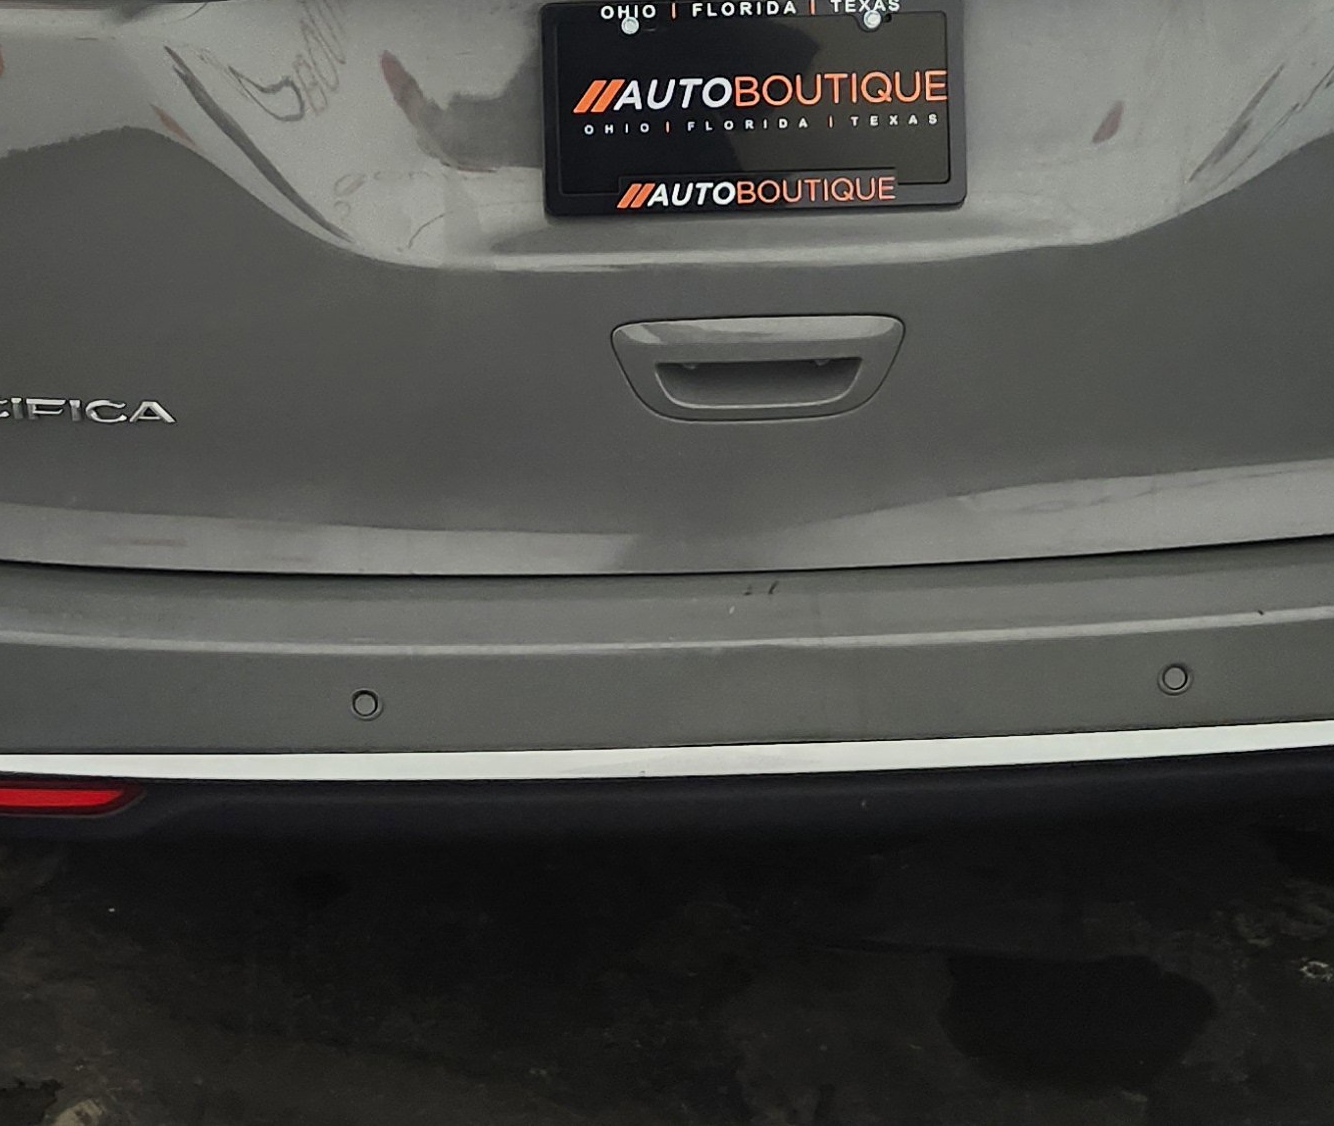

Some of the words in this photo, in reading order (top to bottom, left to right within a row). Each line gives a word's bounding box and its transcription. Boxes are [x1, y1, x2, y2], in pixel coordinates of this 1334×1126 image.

[600, 4, 657, 20] OHIO
[691, 0, 797, 18] FLORIDA
[613, 70, 948, 111] AUTOBOUTIQUE
[584, 122, 650, 135] OHIO
[686, 117, 809, 133] FLORIDA
[850, 113, 939, 127] TEXAS
[646, 176, 897, 208] AUTOBOUTIQUE
